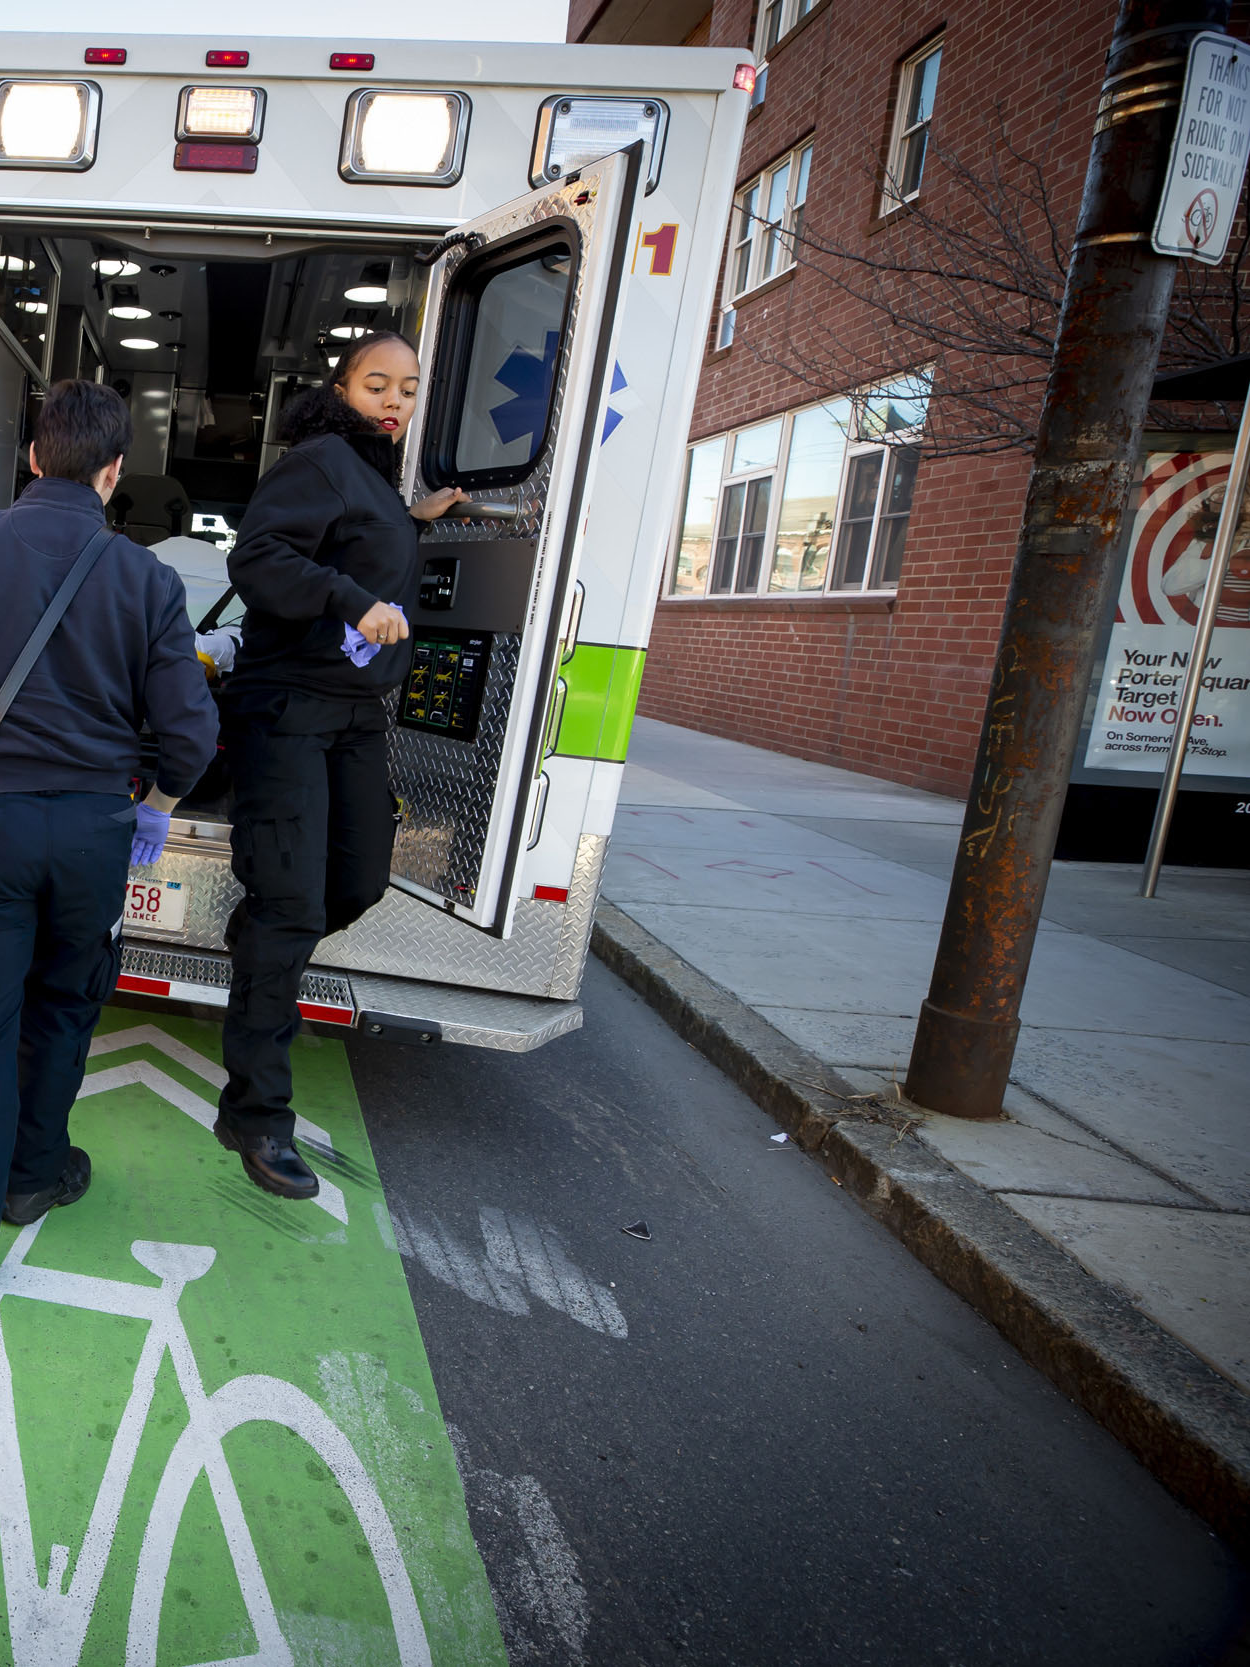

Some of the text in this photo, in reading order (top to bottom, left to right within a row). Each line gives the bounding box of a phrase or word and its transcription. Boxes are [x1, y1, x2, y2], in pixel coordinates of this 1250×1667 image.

[1208, 54, 1250, 92] THANKS
[1197, 86, 1248, 125] FOR NOT
[1186, 118, 1245, 158] RIDING ON
[1181, 152, 1237, 189] SIDEWALK
[1124, 649, 1222, 669] Your Nw
[1117, 668, 1250, 692] Porter quar
[1115, 687, 1178, 708] Target
[1108, 706, 1223, 727] Now Oen.
[1104, 742, 1141, 752] across
[1144, 743, 1170, 753] from
[1106, 731, 1123, 741] On
[1126, 732, 1174, 744] Somervi
[125, 883, 161, 913] 58
